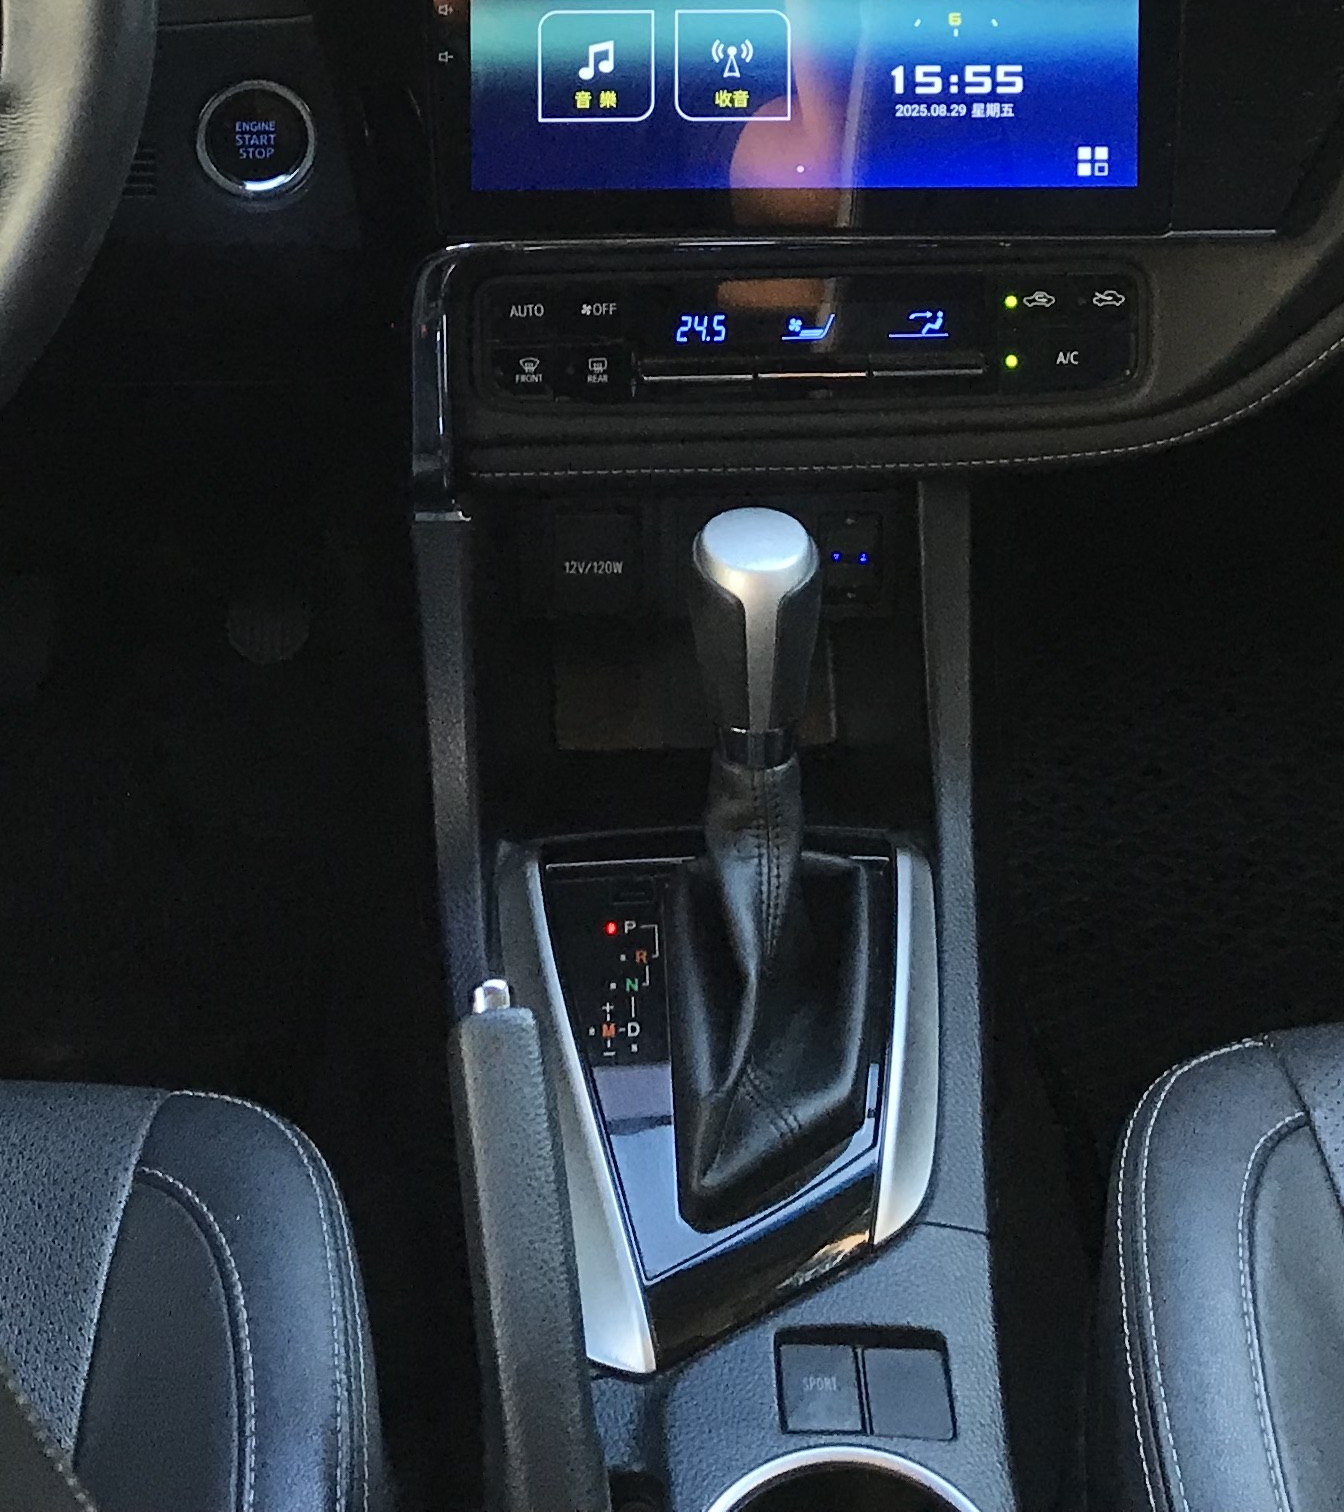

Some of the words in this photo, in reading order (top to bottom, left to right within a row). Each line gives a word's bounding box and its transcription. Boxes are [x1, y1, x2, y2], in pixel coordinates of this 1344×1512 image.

[948, 12, 962, 26] 6
[891, 65, 1024, 95] 15:55
[575, 91, 617, 109] 音樂
[715, 90, 749, 108] 收音
[895, 104, 966, 118] 2025.08.29
[971, 103, 1014, 118] 星期五
[235, 121, 276, 131] ENGINE
[235, 134, 276, 145] START
[239, 148, 274, 159] STOP
[509, 303, 544, 317] AUTO
[593, 303, 617, 316] OFF
[676, 315, 726, 342] 24.5
[1056, 351, 1079, 365] A/C
[515, 374, 543, 383] FRONT
[587, 374, 608, 383] REAR
[564, 560, 623, 574] 12V/120W
[624, 920, 637, 934] P
[635, 949, 648, 964] R
[625, 977, 639, 992] N
[627, 1022, 641, 1037] D
